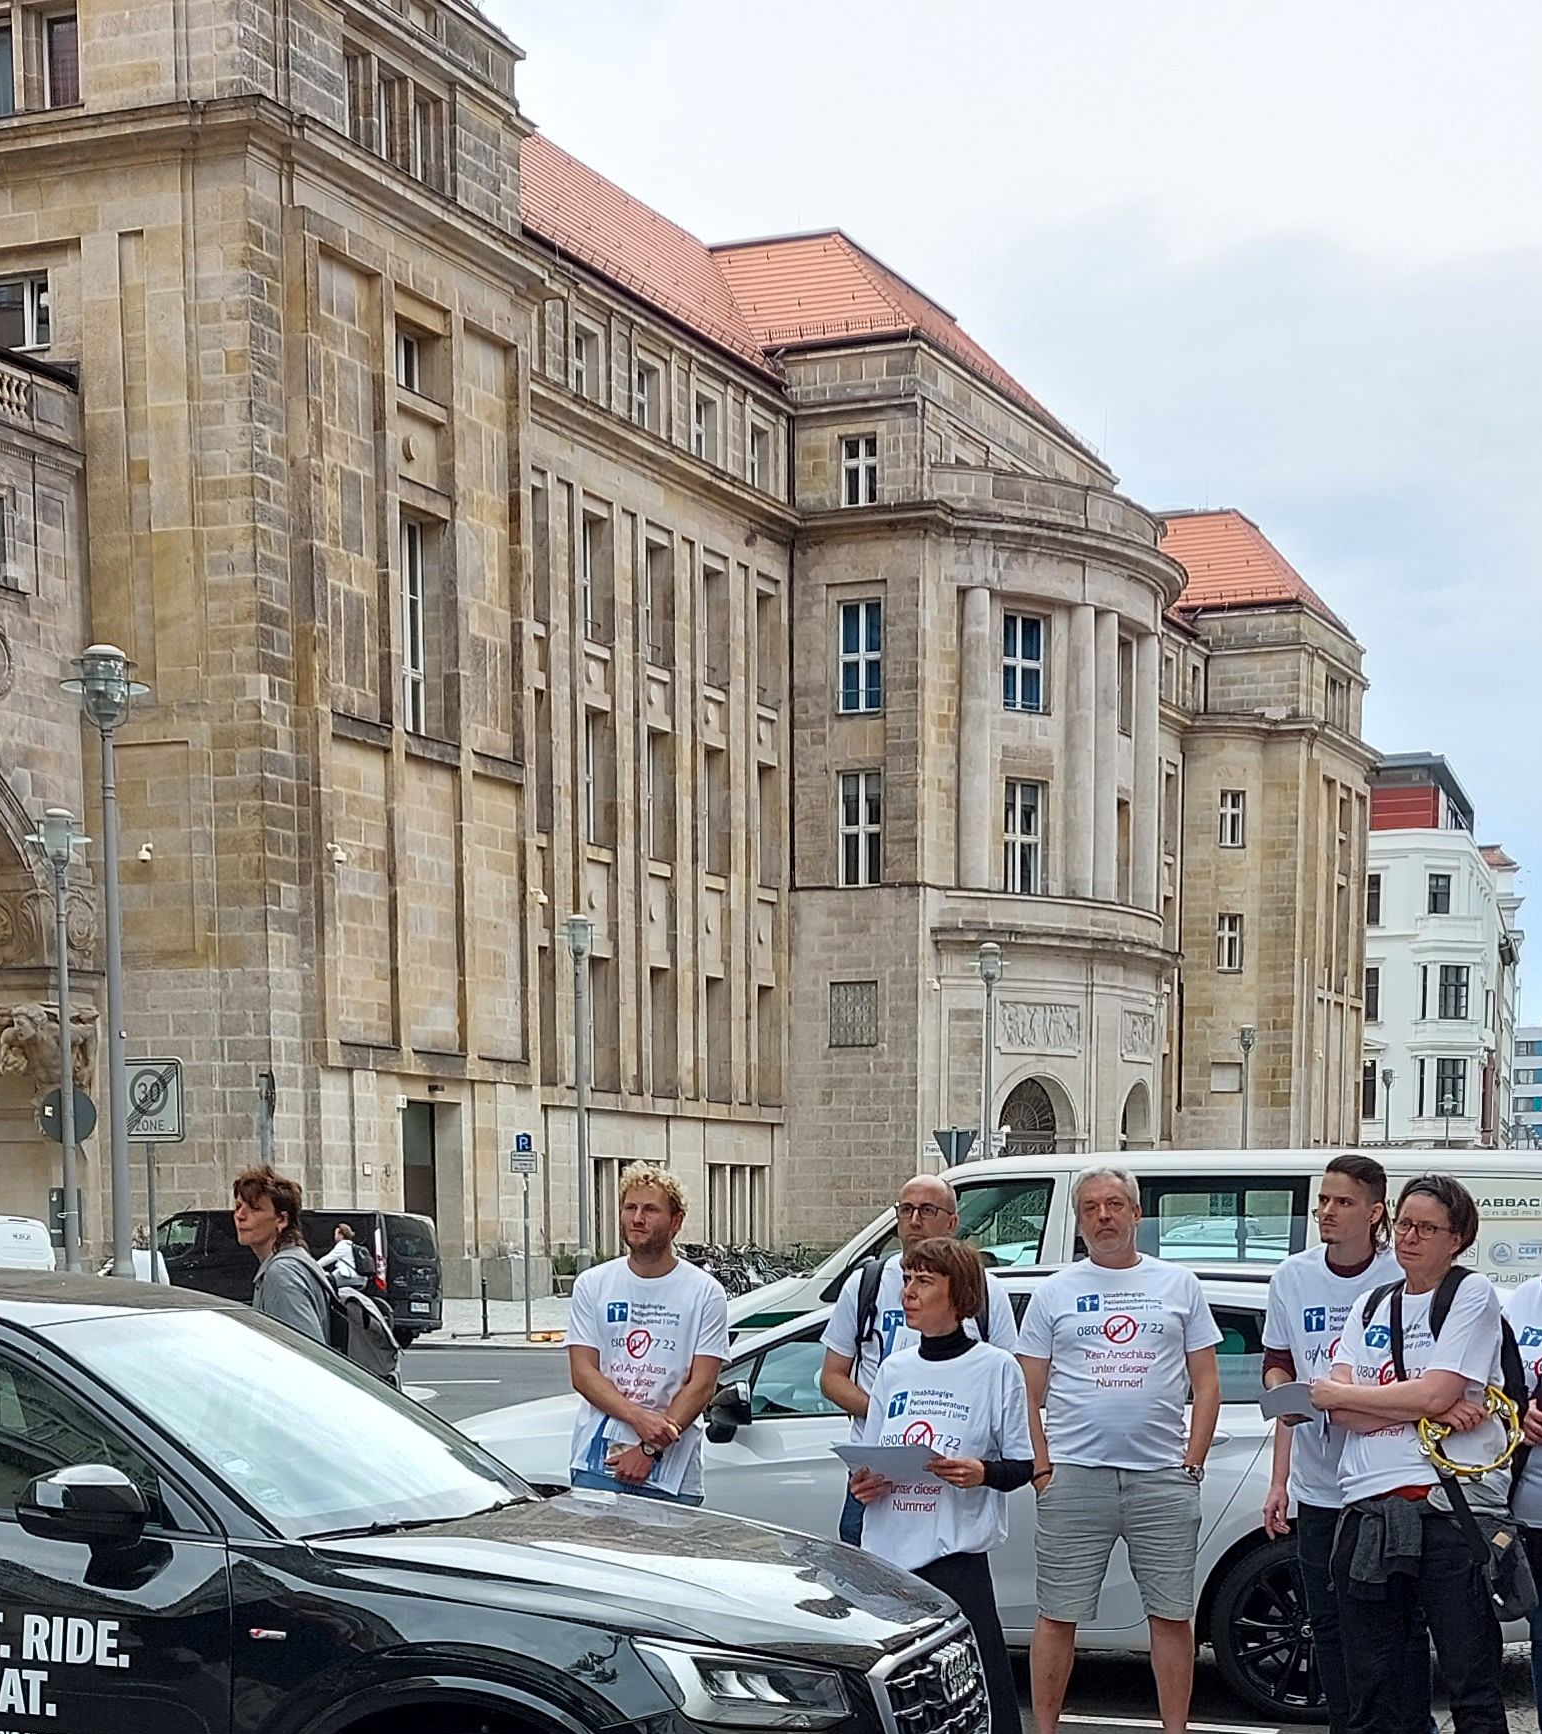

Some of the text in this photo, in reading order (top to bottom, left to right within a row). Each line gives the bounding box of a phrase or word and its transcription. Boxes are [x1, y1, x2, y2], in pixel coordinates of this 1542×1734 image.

[137, 1082, 161, 1103] 30
[135, 1119, 165, 1132] ZONE
[1150, 1323, 1164, 1334] 22
[662, 1340, 676, 1351] 22
[1107, 1349, 1157, 1360] Anschluss
[945, 1435, 962, 1450] 22
[21, 1613, 130, 1668] RIDE.
